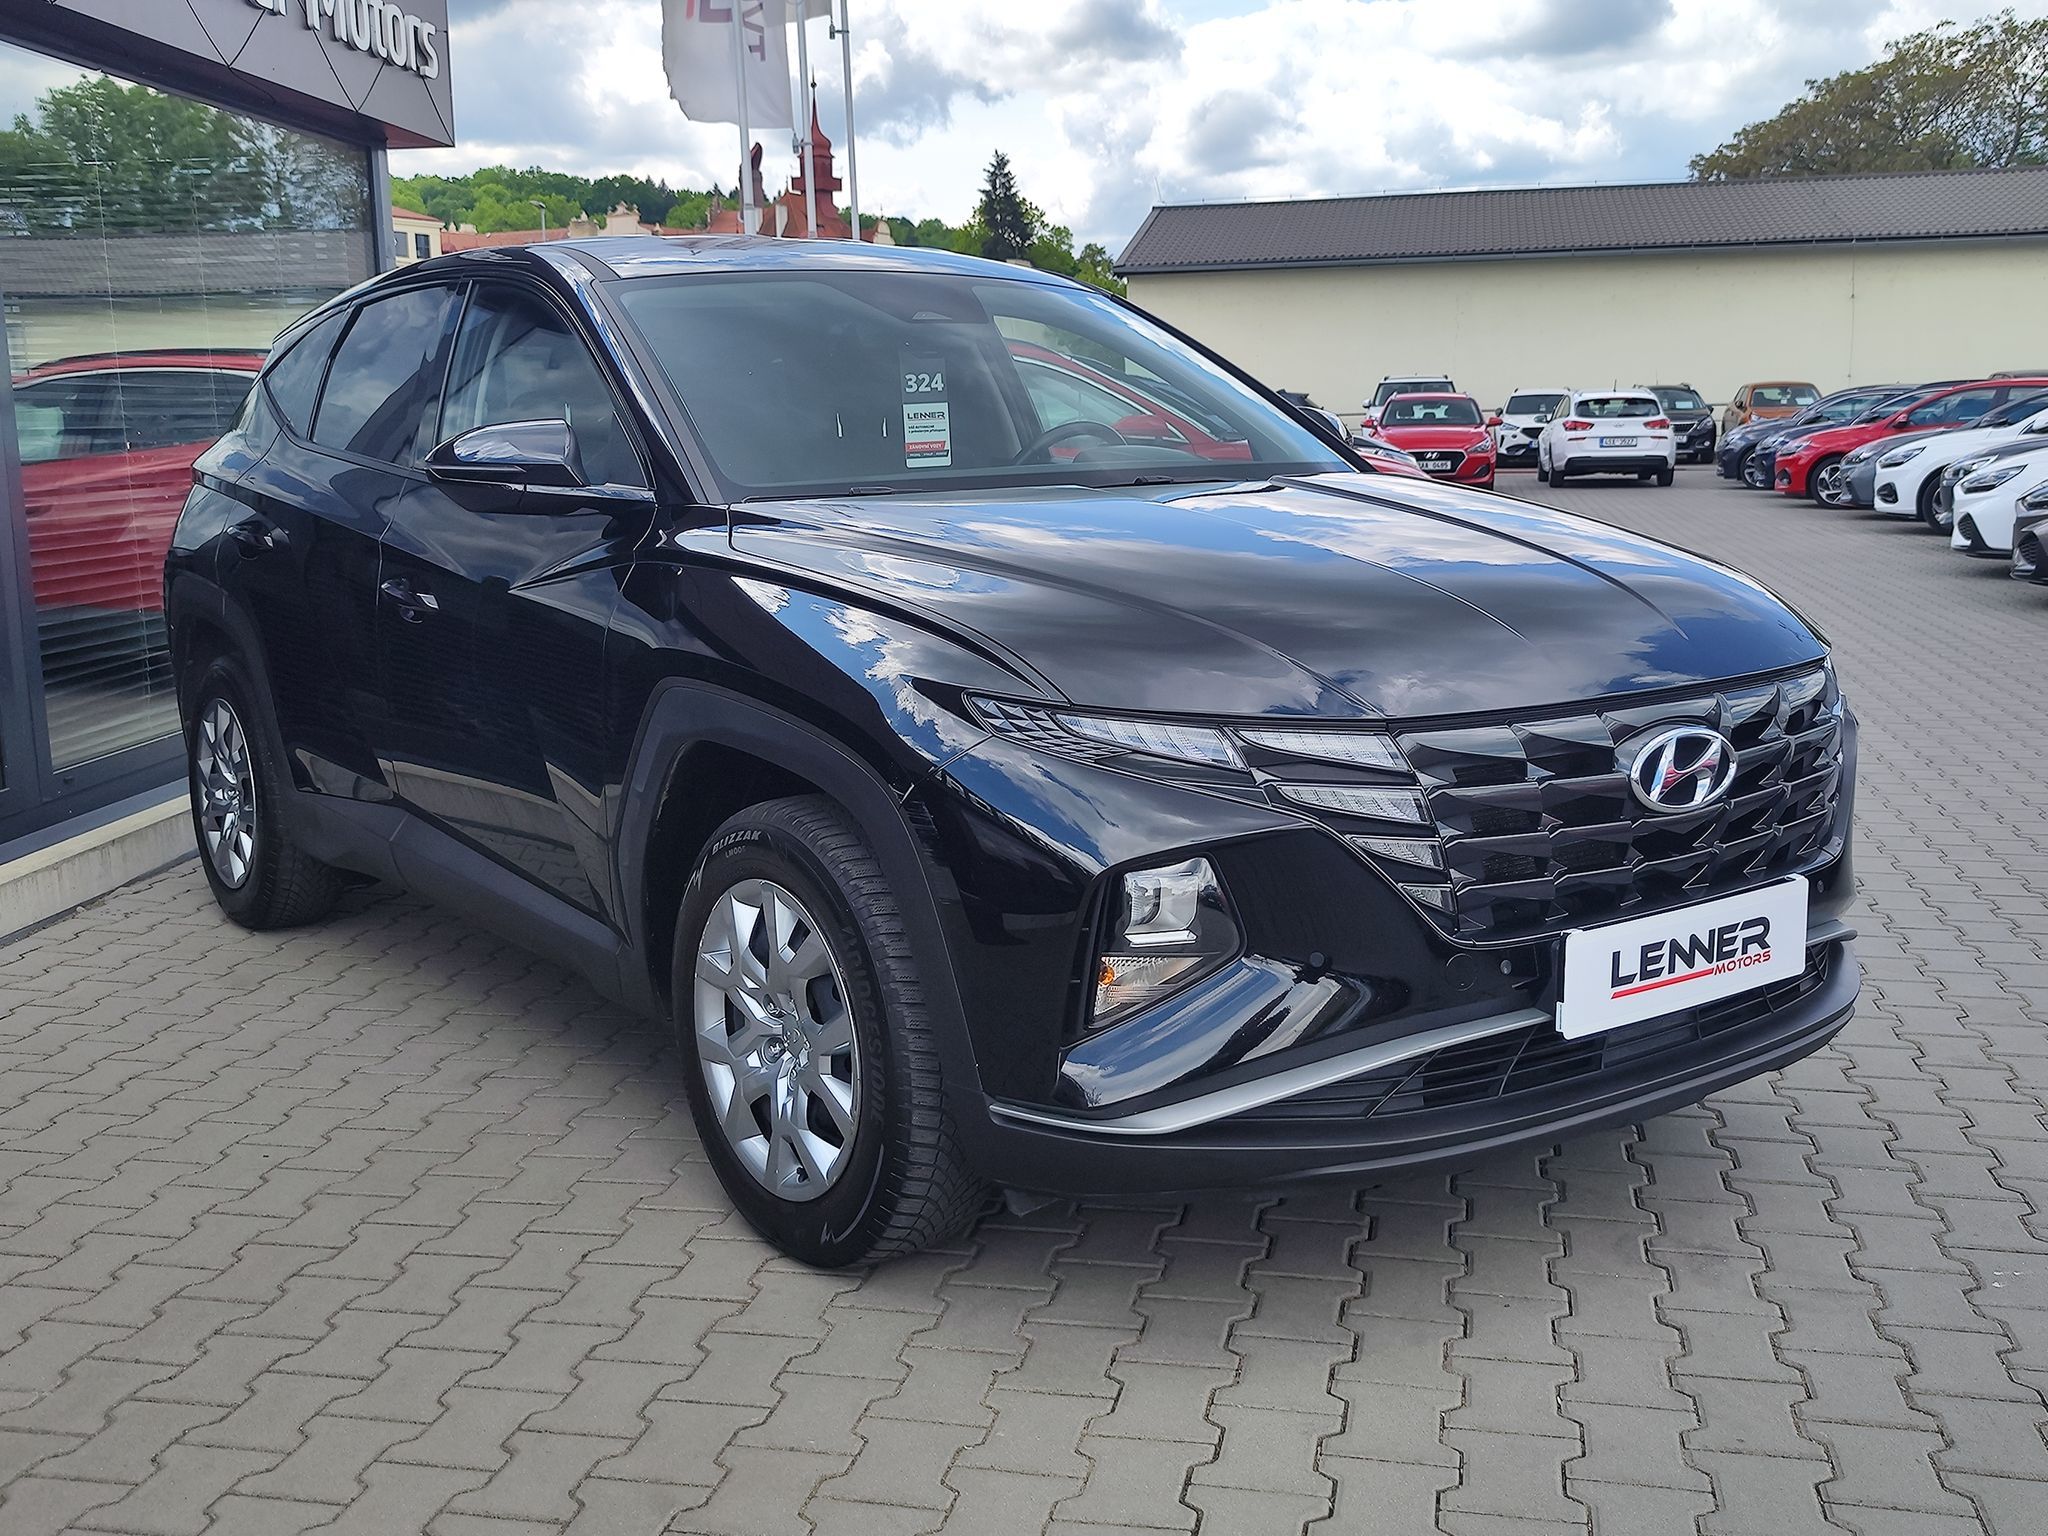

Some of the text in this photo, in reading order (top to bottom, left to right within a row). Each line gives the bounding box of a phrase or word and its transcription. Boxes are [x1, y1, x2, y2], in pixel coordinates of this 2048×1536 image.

[303, 0, 439, 79] Motors
[905, 373, 944, 393] 324
[907, 411, 946, 420] LENNER
[712, 830, 761, 856] BLIZZAK
[1610, 916, 1771, 988] LENNER
[1714, 950, 1771, 976] MOTORS
